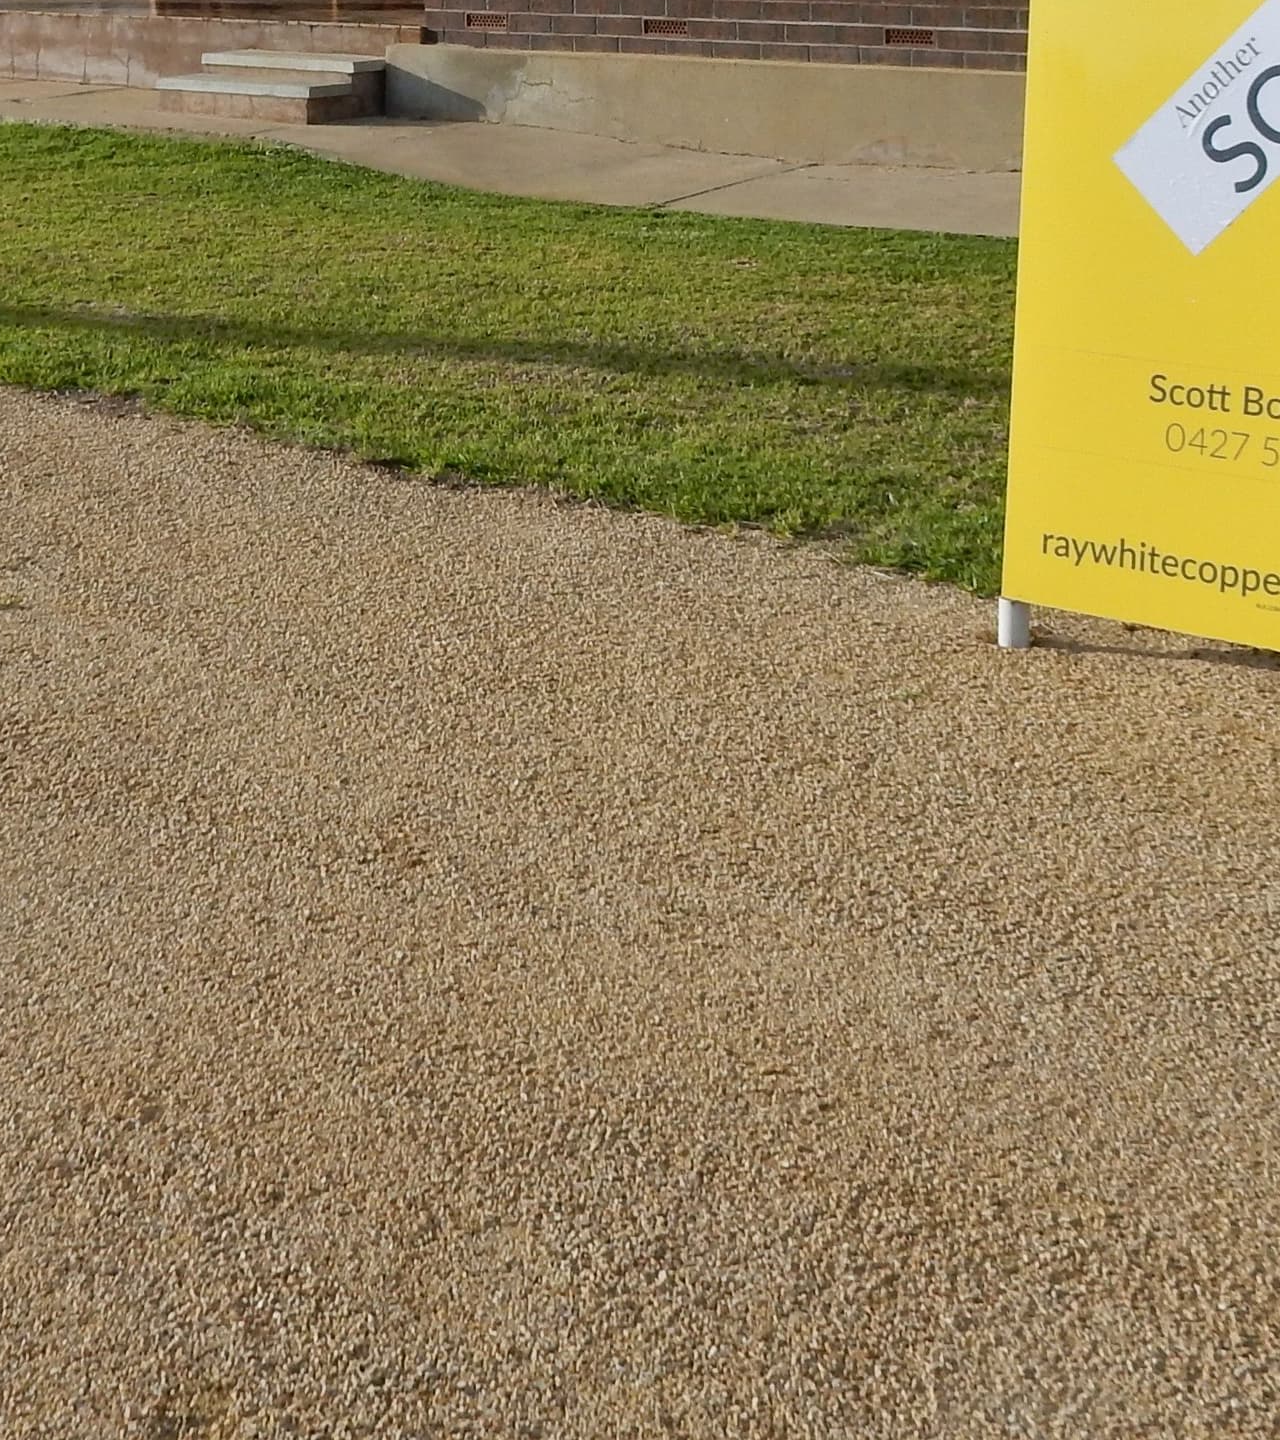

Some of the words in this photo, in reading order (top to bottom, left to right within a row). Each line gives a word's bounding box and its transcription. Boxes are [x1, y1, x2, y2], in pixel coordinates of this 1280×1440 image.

[1174, 36, 1262, 129] Another
[1148, 374, 1232, 413] Scott
[1165, 422, 1250, 461] 0427
